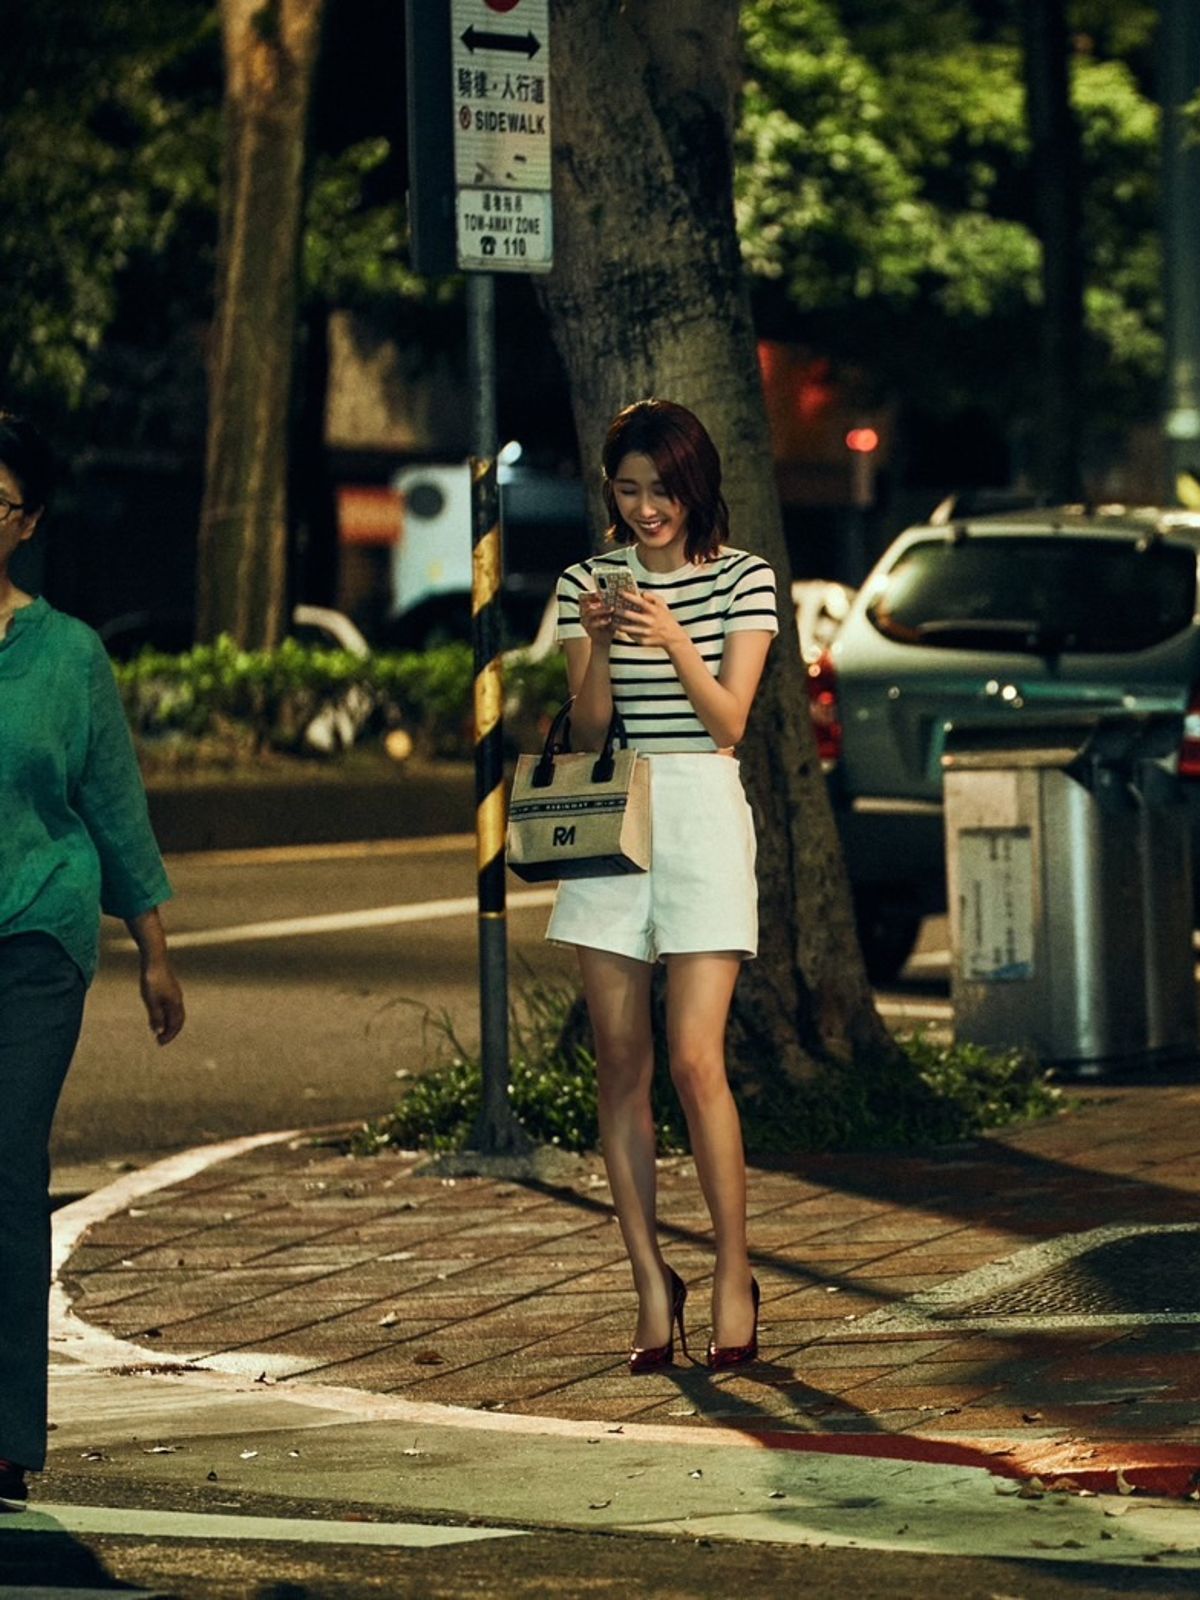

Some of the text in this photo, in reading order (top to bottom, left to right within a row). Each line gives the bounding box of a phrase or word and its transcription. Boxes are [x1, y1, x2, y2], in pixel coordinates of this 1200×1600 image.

[475, 110, 545, 135] SIDEWALK
[464, 213, 541, 235] TOW-AWAY ZONE
[503, 237, 527, 257] 110
